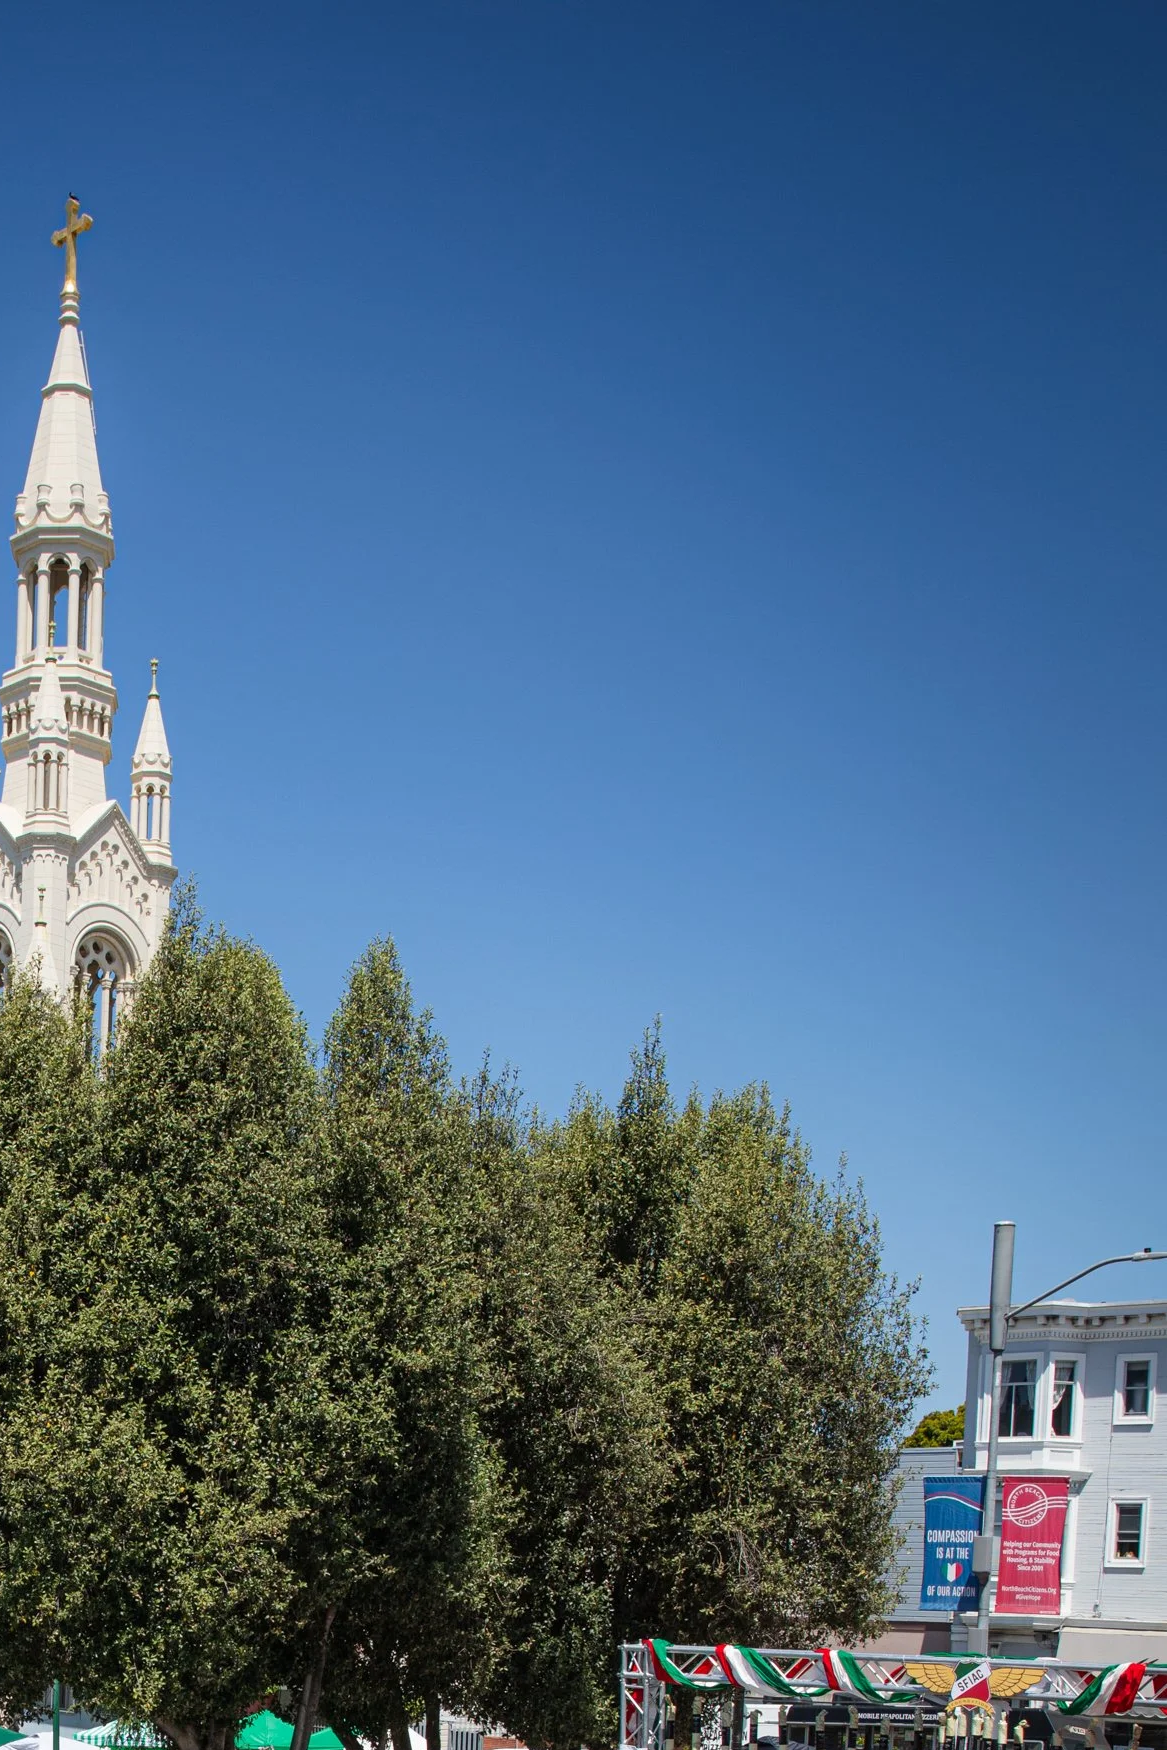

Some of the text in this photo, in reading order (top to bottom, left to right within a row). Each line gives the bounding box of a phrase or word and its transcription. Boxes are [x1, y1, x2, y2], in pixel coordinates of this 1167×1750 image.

[1010, 1487, 1042, 1508] NORTH BEACH
[1018, 1511, 1044, 1525] CITIZENS
[1003, 1540, 1022, 1549] Helping
[1032, 1541, 1061, 1549] Community
[936, 1547, 969, 1559] IS AT THE
[927, 1586, 976, 1597] OF OUR ACTION
[958, 1669, 984, 1692] SFIAC
